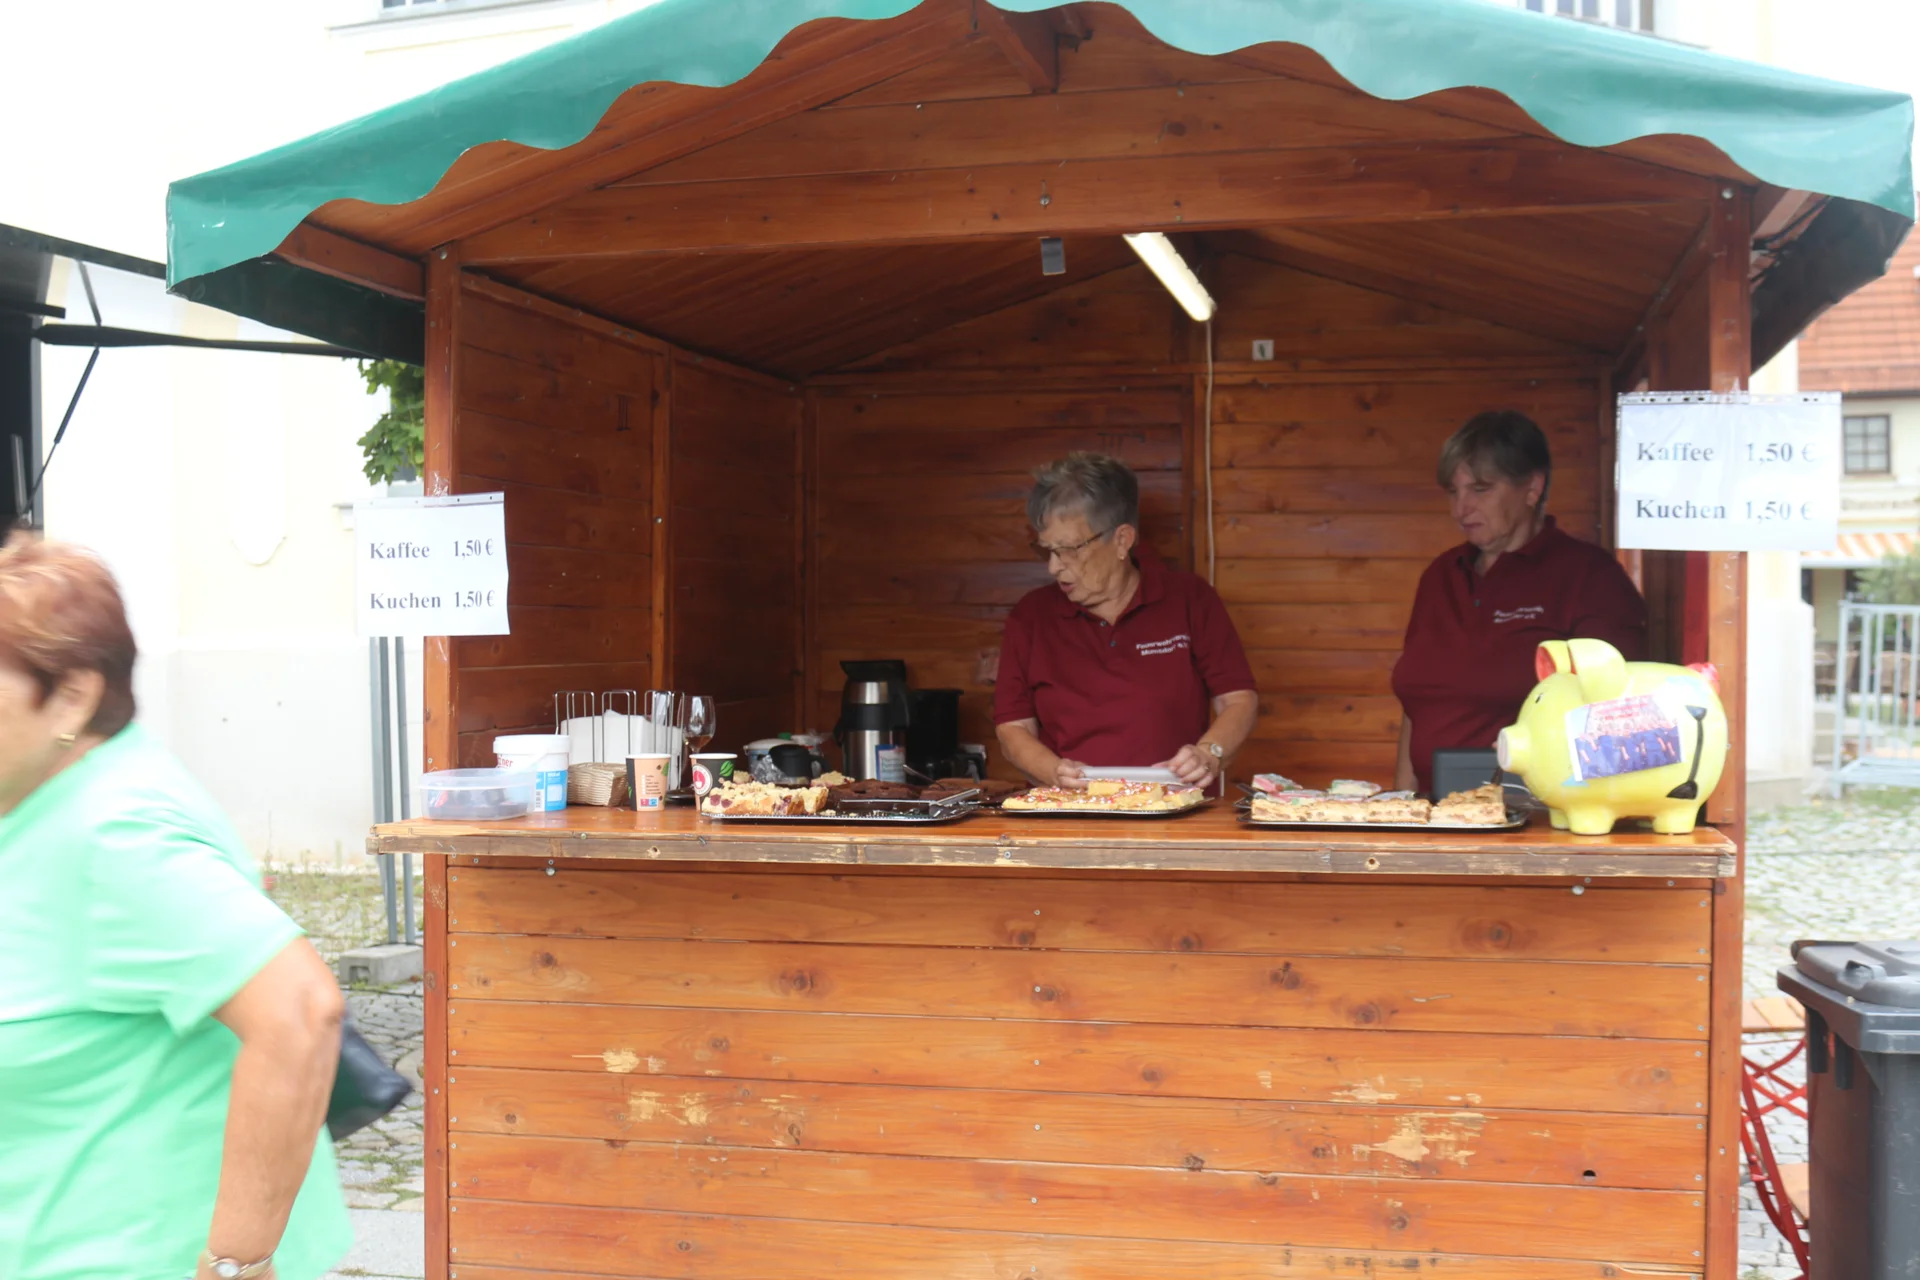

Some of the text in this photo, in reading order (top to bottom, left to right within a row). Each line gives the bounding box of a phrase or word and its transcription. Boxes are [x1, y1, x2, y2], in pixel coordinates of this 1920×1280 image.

[1637, 442, 1816, 463] Kaffee 1,50 €
[1636, 499, 1814, 522] Kuchen 1,50 €
[370, 542, 430, 560] Kaffee
[370, 592, 441, 609] Kuchen
